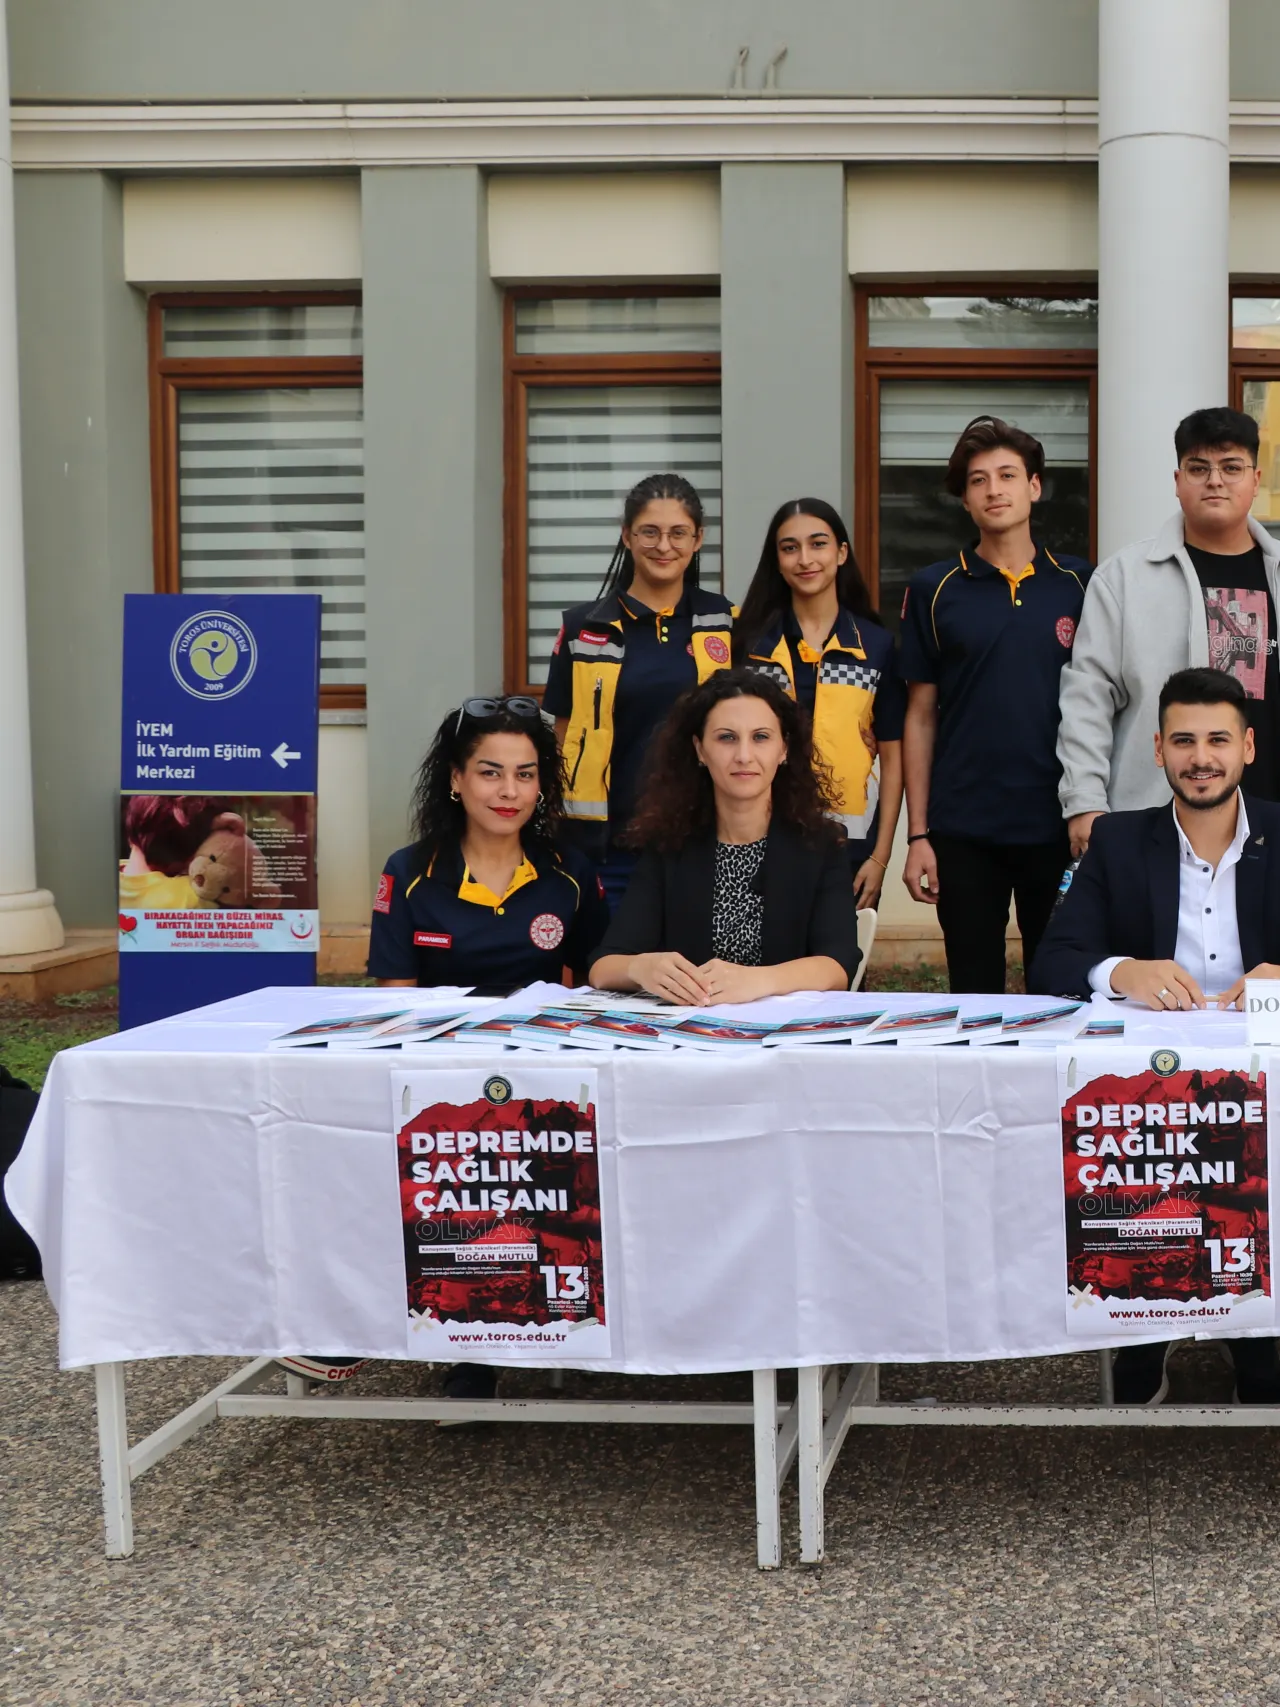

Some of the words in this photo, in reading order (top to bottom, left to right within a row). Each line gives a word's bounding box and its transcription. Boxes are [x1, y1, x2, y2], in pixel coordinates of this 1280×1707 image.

[179, 625, 201, 653] TOROS
[204, 683, 224, 691] 2009
[136, 720, 173, 736] İYEM
[137, 741, 156, 757] İlk
[160, 744, 210, 758] Yardım
[214, 744, 261, 761] Eğitim
[137, 765, 195, 778] Merkezi
[1076, 1100, 1263, 1128] DEPREMDE
[411, 1130, 594, 1154] DEPREMDE
[1076, 1127, 1200, 1157] SAĞLIK
[412, 1154, 533, 1183] SAĞLIK
[1078, 1161, 1235, 1193] ÇALIŞANI
[414, 1188, 568, 1220] ÇALIŞANI
[1078, 1191, 1201, 1216] OLMAK
[415, 1217, 536, 1242] OLMAK
[1120, 1227, 1158, 1236] DOĞAN
[1162, 1228, 1198, 1236] MUTLU
[456, 1252, 495, 1260] DOĞAN
[1204, 1238, 1250, 1272] 13
[540, 1266, 585, 1300] 13
[1109, 1306, 1231, 1318] www.toros.edu.tr
[448, 1332, 567, 1342] www.toros.edu.tr
